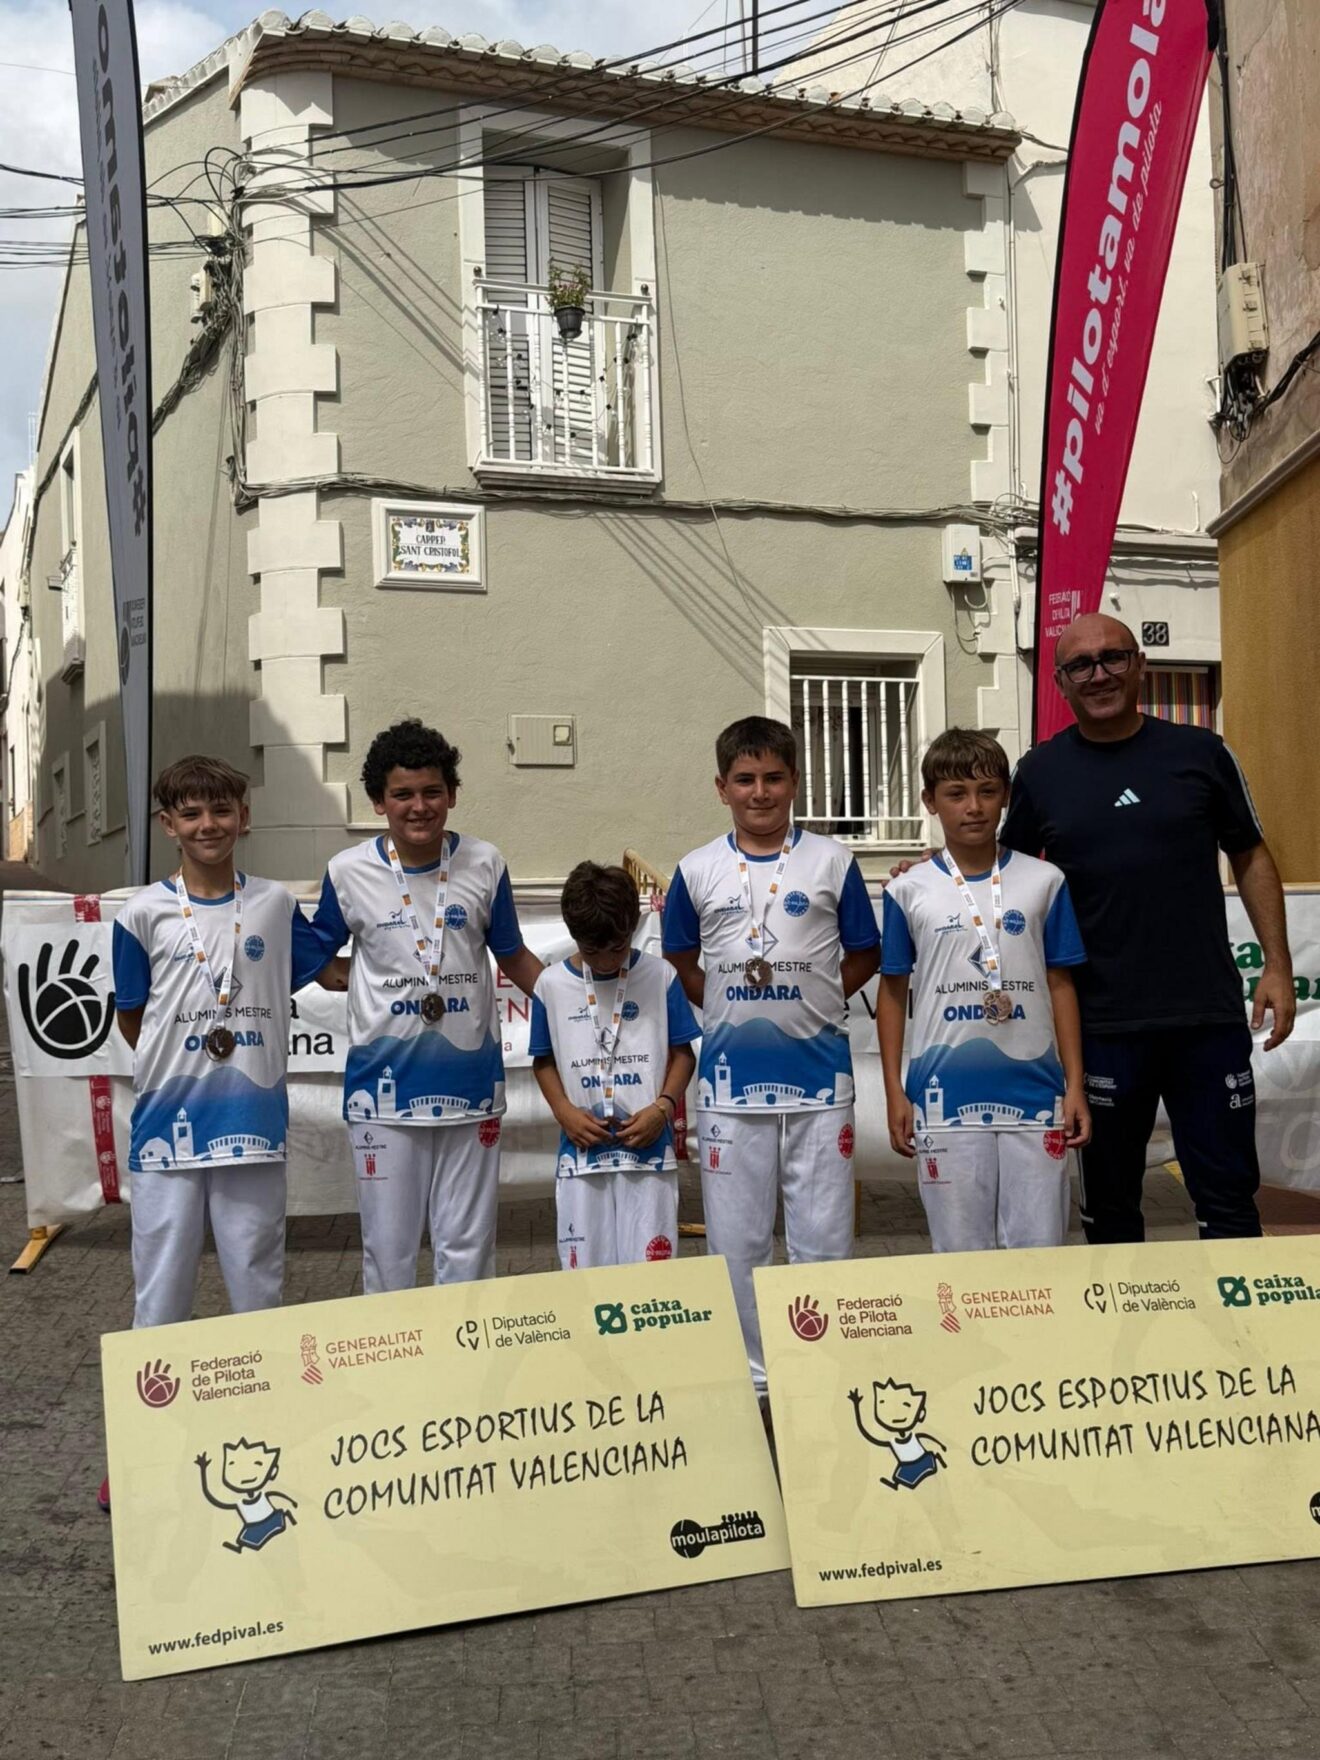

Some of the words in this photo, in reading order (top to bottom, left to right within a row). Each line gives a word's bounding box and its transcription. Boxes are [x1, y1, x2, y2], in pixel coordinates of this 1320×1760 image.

[1140, 101, 1162, 195] pilota
[400, 545, 421, 556] SANT
[1143, 623, 1168, 644] 38
[769, 961, 813, 973] MESTRE
[382, 976, 430, 988] ALUMIN
[438, 973, 479, 985] MESTRE
[935, 981, 989, 994] ALUMINIS
[1001, 981, 1035, 992] ESTRE
[726, 984, 803, 1002] ONDARA
[174, 1006, 232, 1024] ALUMINS
[235, 1006, 272, 1019] MESTRE
[390, 996, 470, 1016] ONRA
[943, 1004, 1026, 1022] ONDA
[614, 1054, 650, 1065] MESTRE
[580, 1072, 643, 1089] ONARA
[1117, 1280, 1180, 1297] Diputació
[1253, 1274, 1305, 1289] caixa
[836, 1294, 903, 1311] Federació
[961, 1288, 1053, 1304] GENERALITAT
[1122, 1300, 1140, 1312] de
[1140, 1297, 1197, 1311] València
[631, 1298, 682, 1315] caixa
[965, 1303, 1055, 1319] VALENCIANA
[492, 1310, 557, 1331] Diputació
[632, 1308, 712, 1332] popular
[839, 1313, 856, 1325] de
[859, 1310, 897, 1323] Pilota
[495, 1335, 513, 1348] de
[514, 1328, 571, 1345] València
[840, 1324, 913, 1339] Valenciana
[325, 1329, 423, 1354] GENERALITAT
[191, 1350, 263, 1373] Federació
[328, 1345, 424, 1369] VALENCIANA
[192, 1374, 211, 1387] de
[214, 1367, 256, 1384] Pilota
[192, 1381, 271, 1402] Valenciana
[974, 1380, 1046, 1415] JOCS
[1059, 1370, 1208, 1409] ESPORTIUS
[1216, 1367, 1256, 1399] DE
[1267, 1364, 1296, 1396] LA
[331, 1425, 408, 1466] JOCS
[422, 1401, 576, 1452] ESPORTIUS
[585, 1396, 625, 1430] DE
[637, 1390, 664, 1423] LA
[971, 1423, 1133, 1466] COMUNITAT
[1145, 1410, 1320, 1453] VALENCIANA
[324, 1462, 497, 1519] COMUNITAT
[510, 1436, 688, 1490] VALENCIANA
[671, 1523, 763, 1547] moulapilota
[818, 1558, 943, 1582] www.fedpival.es
[148, 1621, 284, 1655] www.fedpival.es
